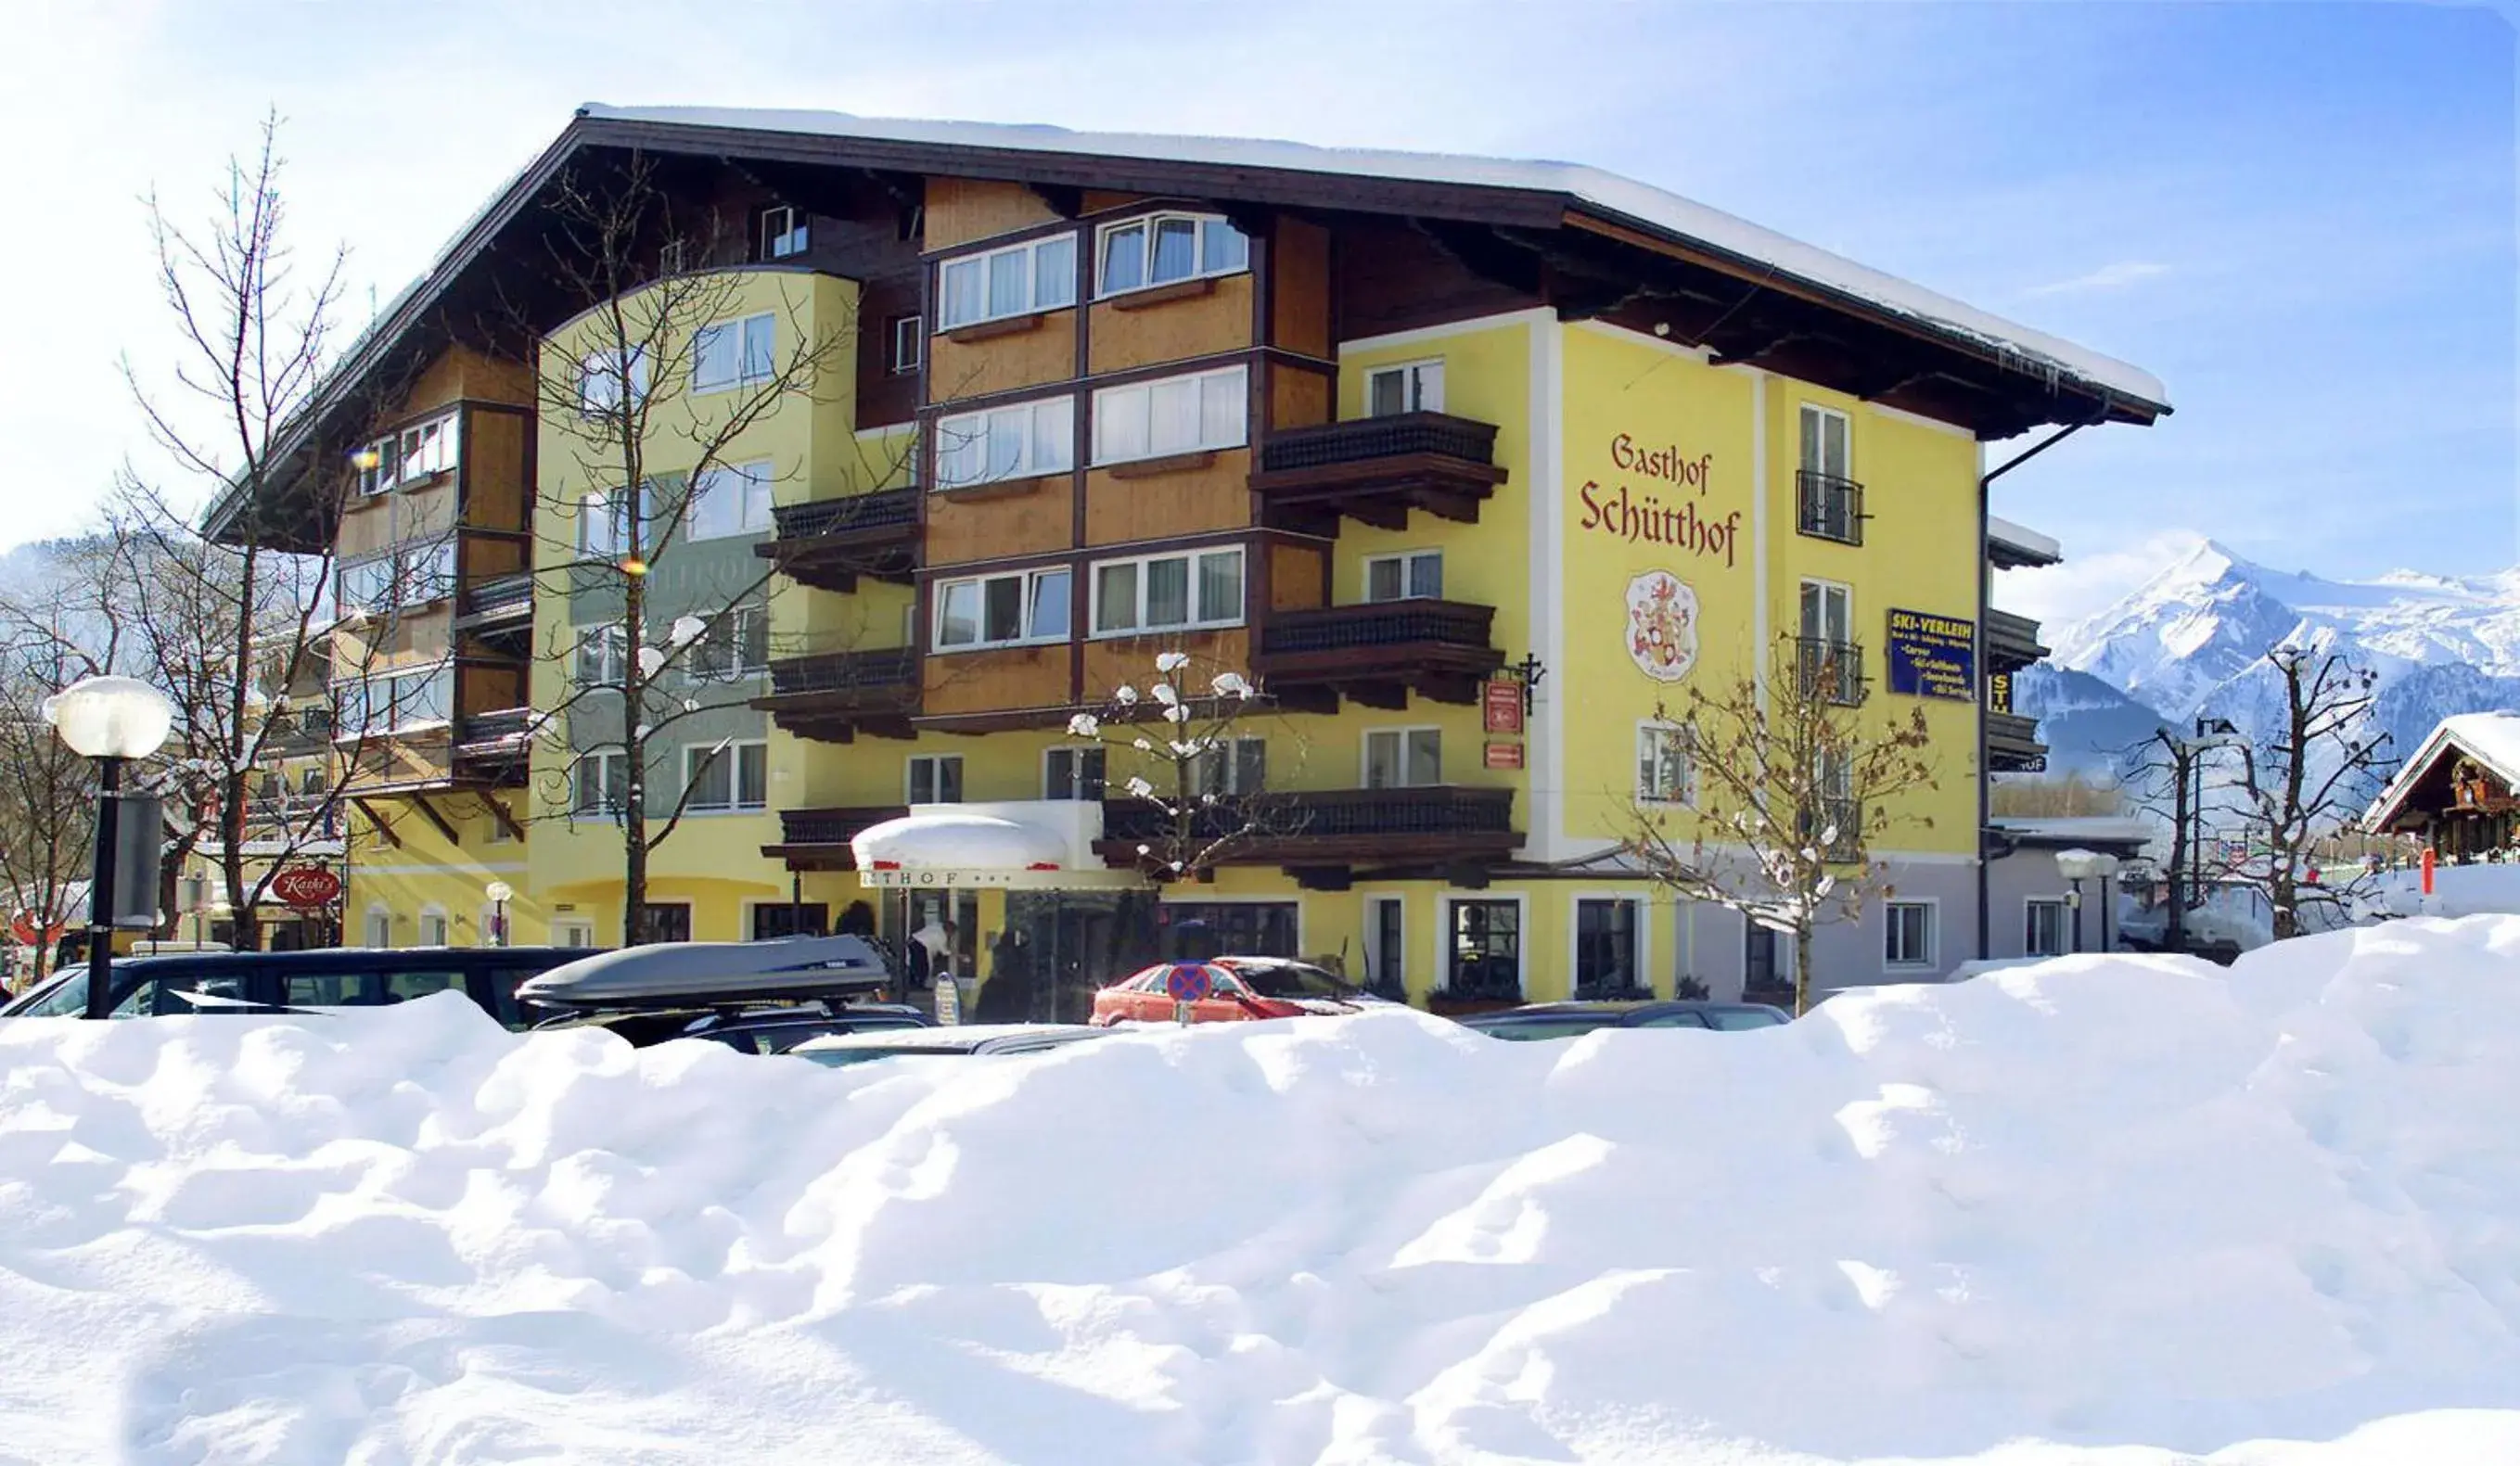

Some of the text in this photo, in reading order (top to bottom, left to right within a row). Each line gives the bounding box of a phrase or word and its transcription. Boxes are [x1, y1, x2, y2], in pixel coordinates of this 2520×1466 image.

[1611, 433, 1712, 496] Gasthof
[1580, 480, 1742, 568] Schütthof
[1892, 613, 1972, 639] SKI-VERLEIH
